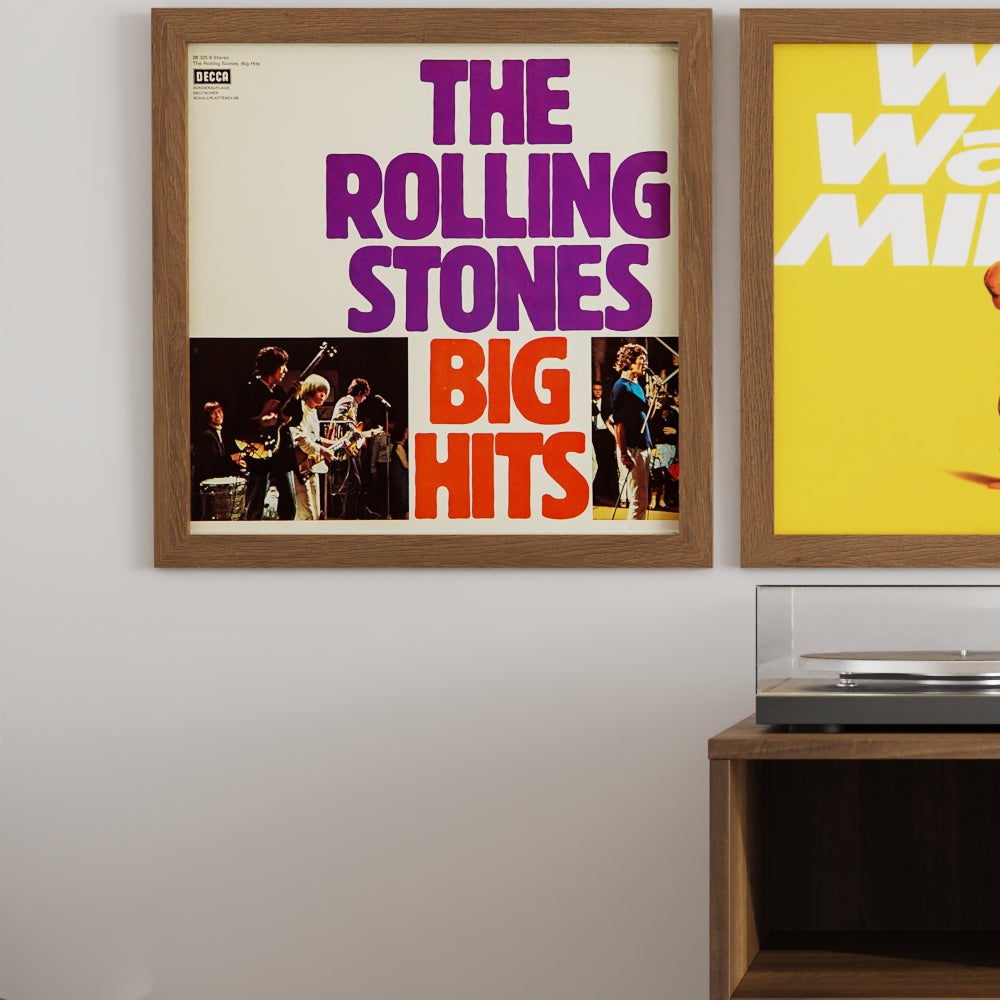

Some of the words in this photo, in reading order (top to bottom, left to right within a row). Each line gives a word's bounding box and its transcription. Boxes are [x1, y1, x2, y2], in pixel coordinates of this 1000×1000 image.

[196, 71, 229, 82] DECCA
[419, 58, 573, 146] THE
[326, 151, 671, 239] ROLLING
[347, 244, 653, 333] STONES
[429, 337, 571, 425] BIG
[414, 431, 590, 520] HITS
